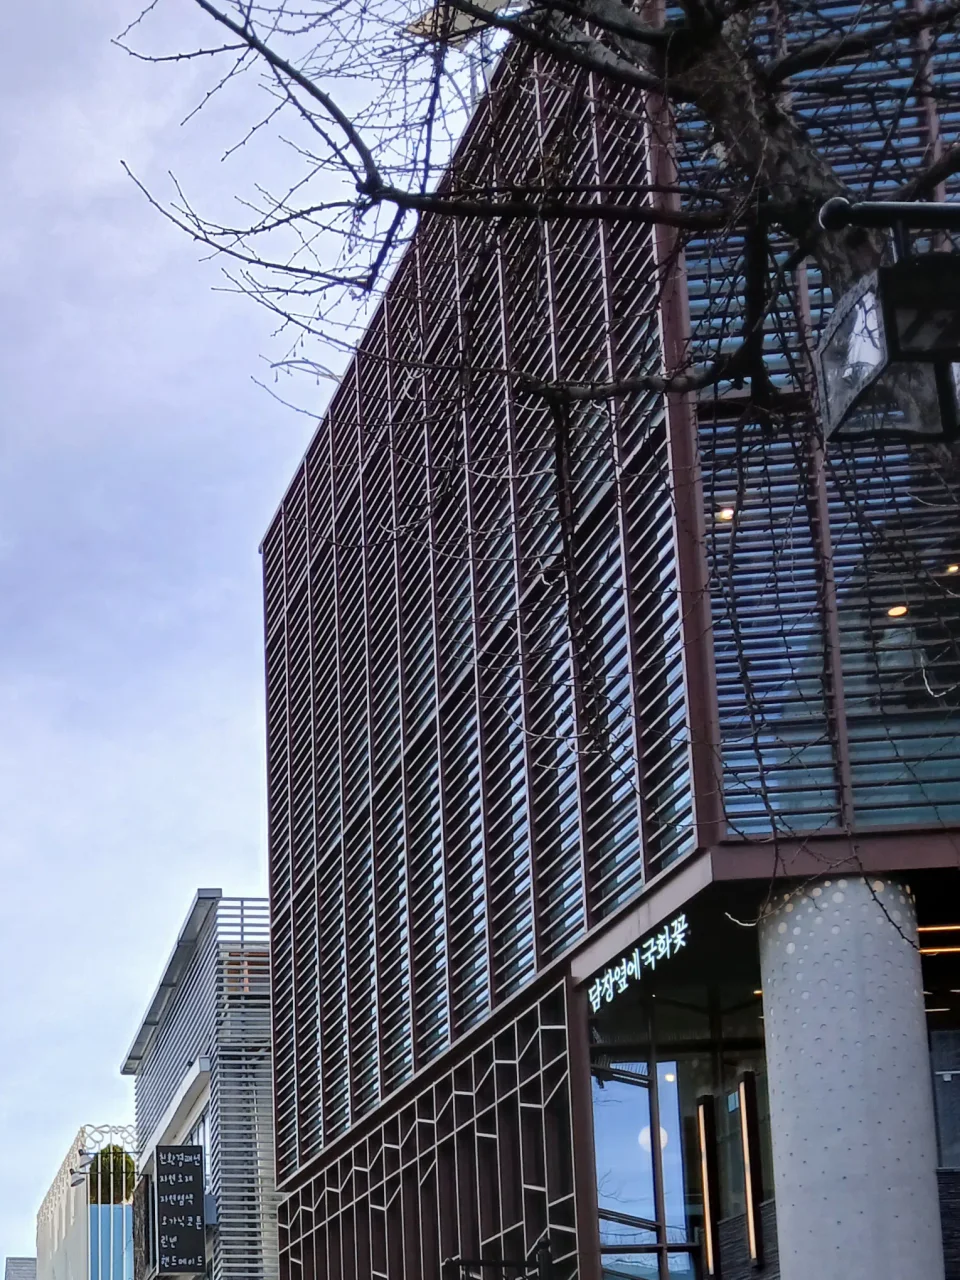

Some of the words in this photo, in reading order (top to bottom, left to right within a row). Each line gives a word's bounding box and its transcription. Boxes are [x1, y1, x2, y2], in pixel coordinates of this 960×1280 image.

[159, 1173, 194, 1186] 자연소재
[159, 1192, 194, 1207] 자연염색
[161, 1215, 202, 1230] 오가닉코튼
[160, 1235, 178, 1249] 린넨
[160, 1254, 203, 1268] 핸드메이드
